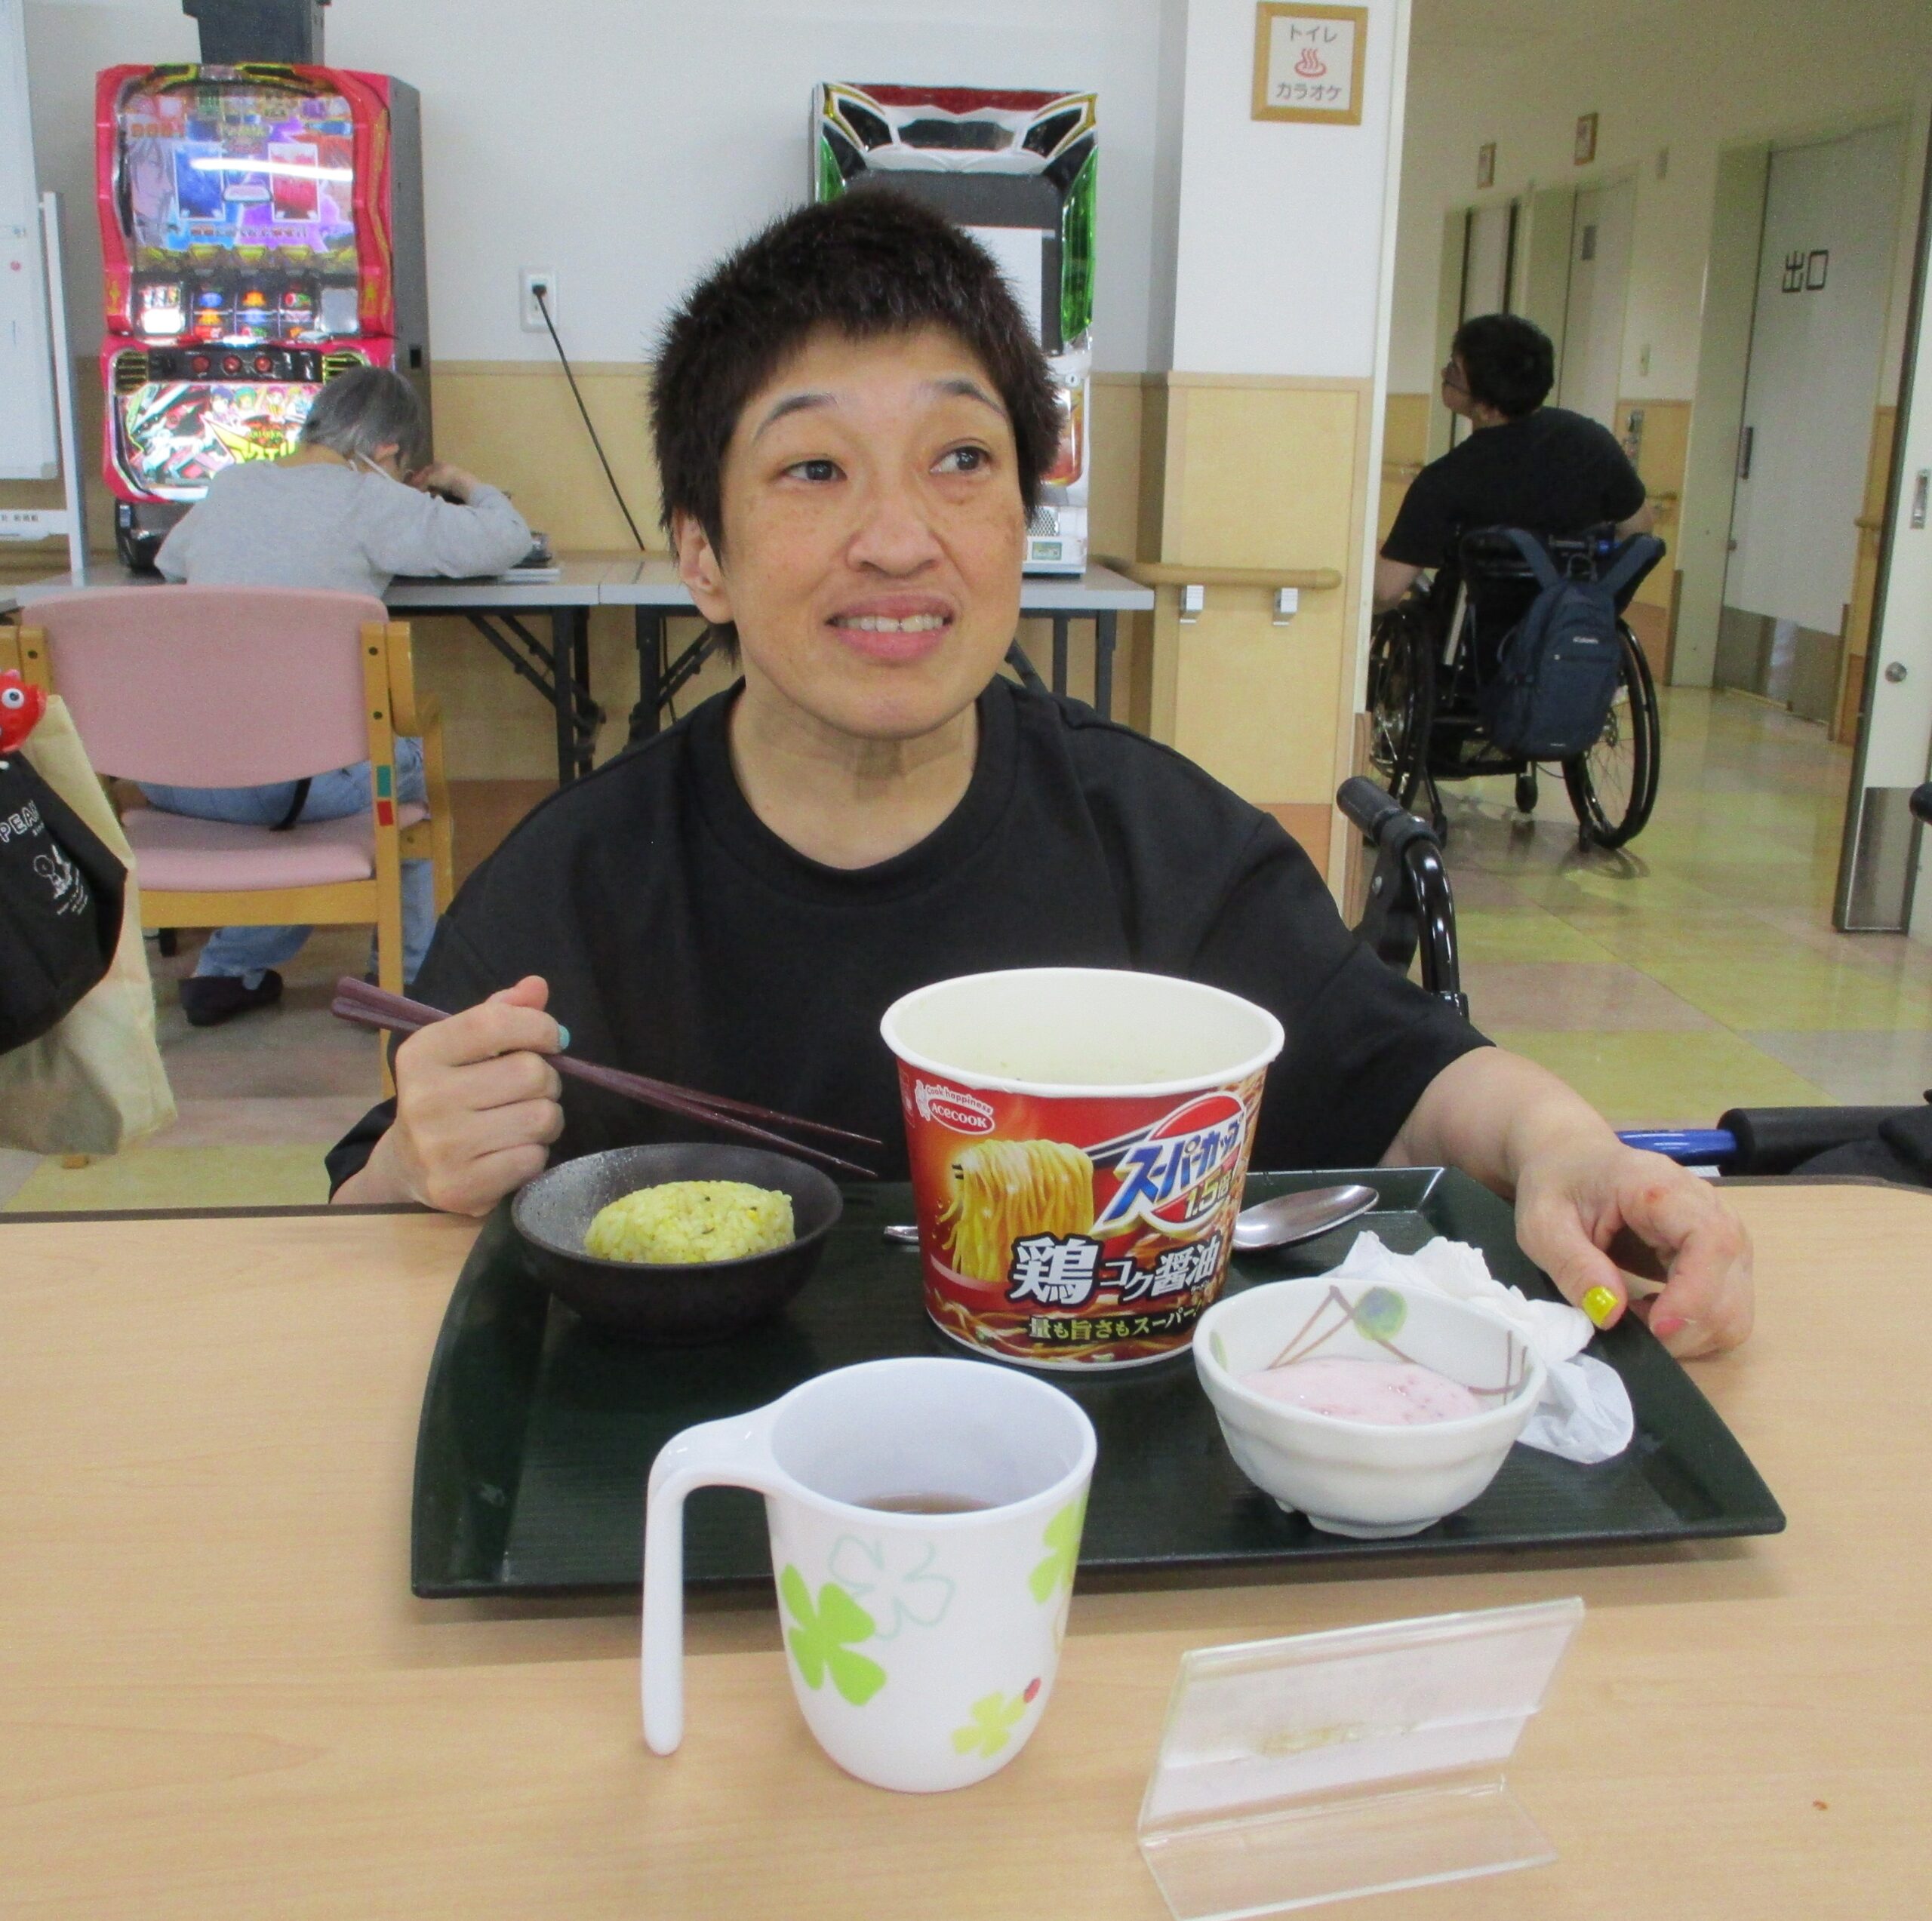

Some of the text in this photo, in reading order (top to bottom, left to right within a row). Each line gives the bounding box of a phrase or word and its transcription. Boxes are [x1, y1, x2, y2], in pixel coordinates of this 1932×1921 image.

[1290, 24, 1338, 43] トイレ
[1276, 81, 1342, 101] カラオケ
[1782, 250, 1829, 293] 出口
[945, 1089, 992, 1114] happiness
[1103, 1112, 1245, 1223] スーパーカップ
